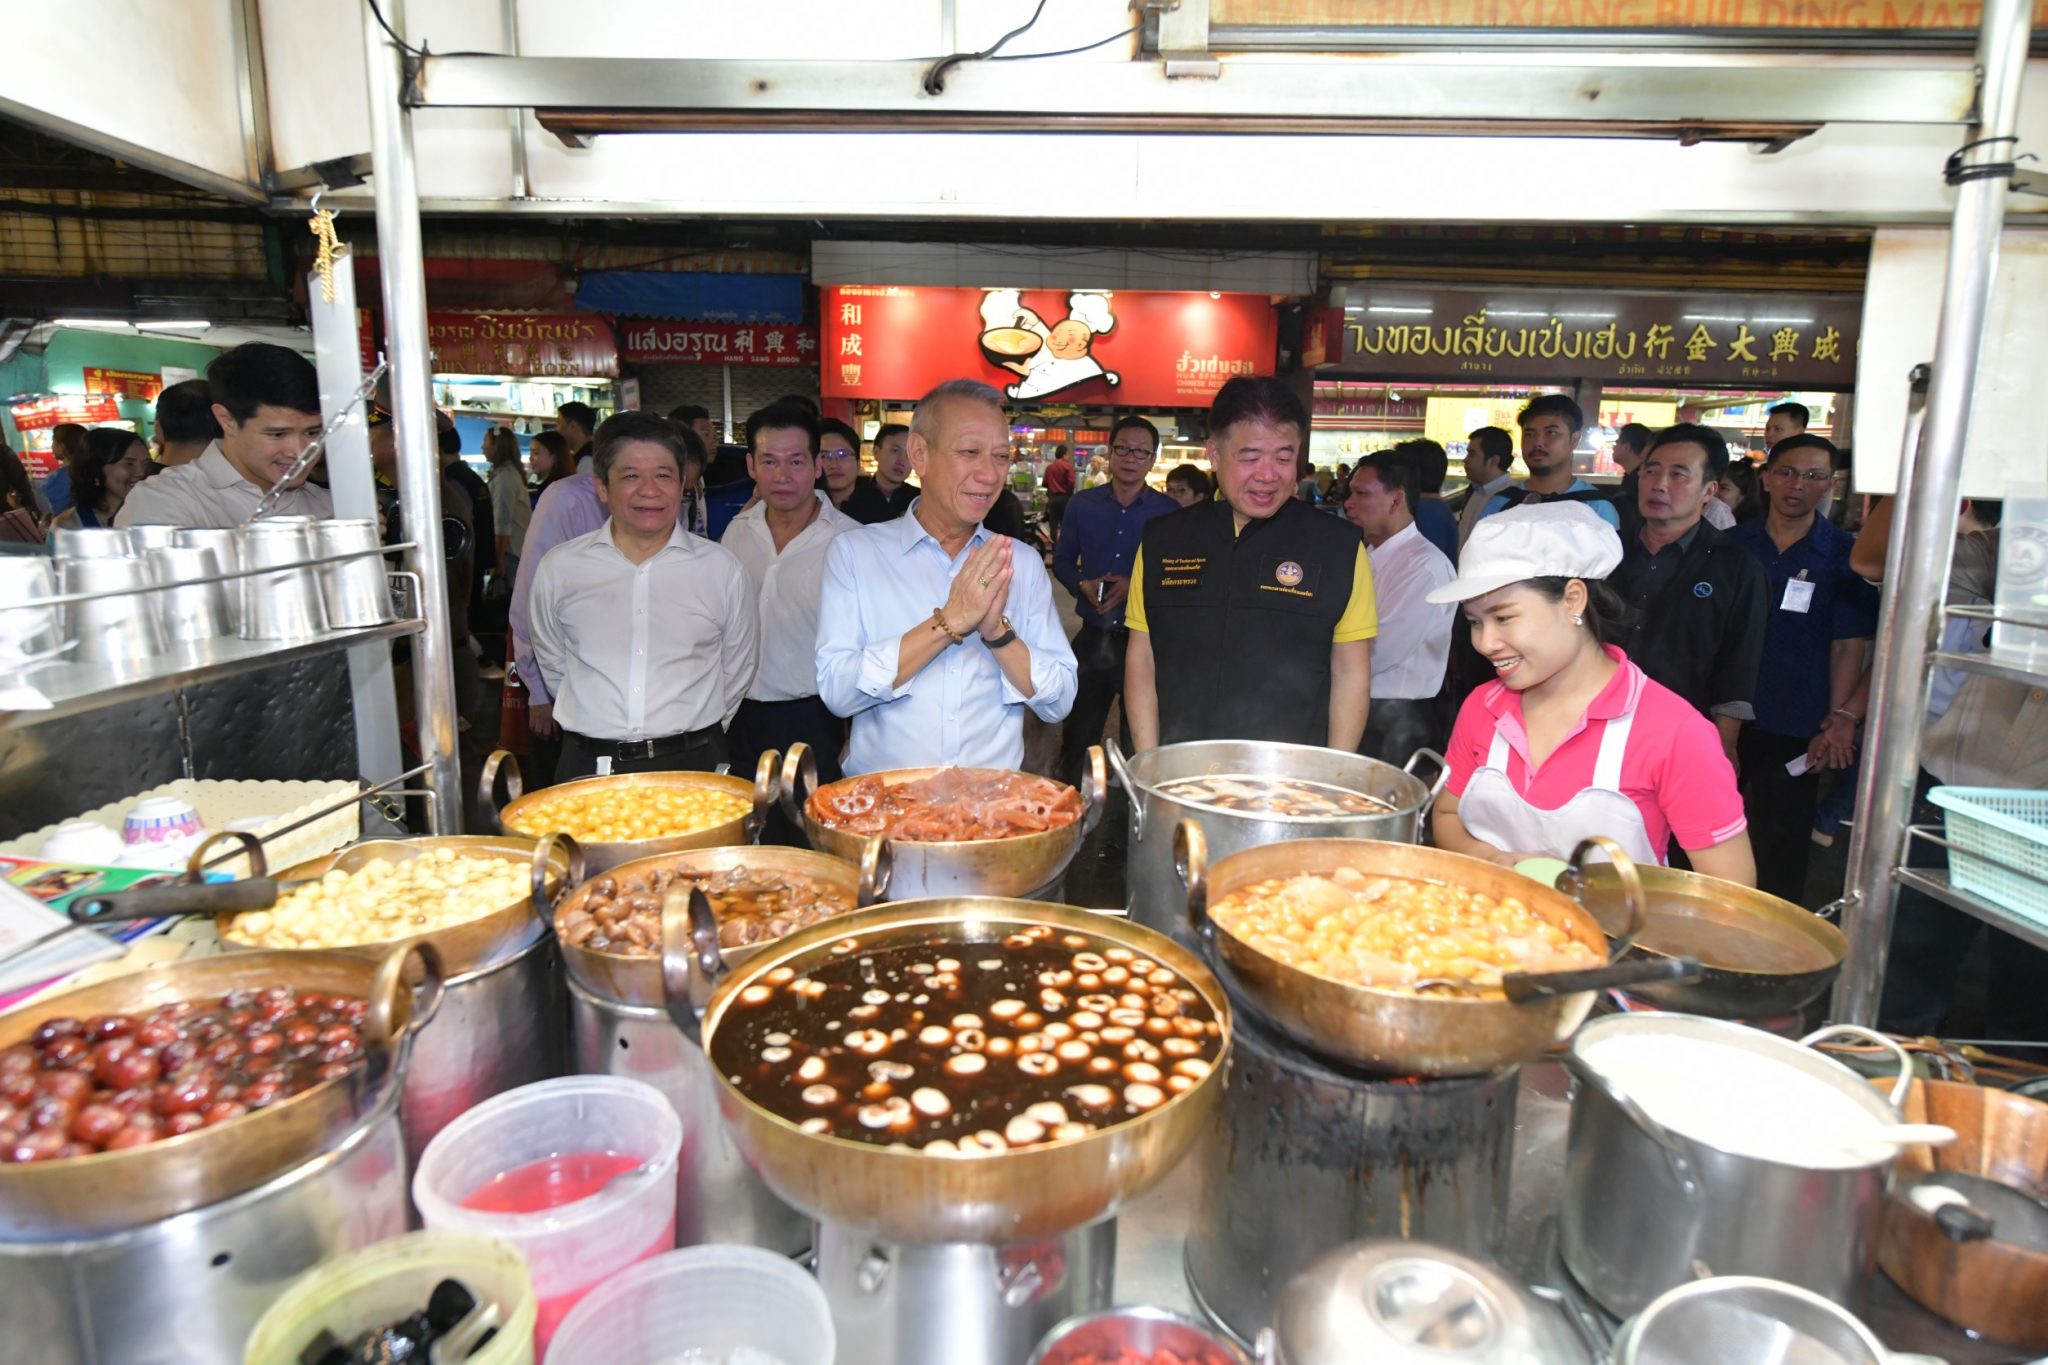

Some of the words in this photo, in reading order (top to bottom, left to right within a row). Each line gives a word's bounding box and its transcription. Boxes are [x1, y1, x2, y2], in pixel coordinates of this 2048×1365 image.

[1656, 0, 1867, 28] BUILDING
[628, 327, 728, 361] แสงอรุณ
[1176, 372, 1195, 380] HUA
[1198, 372, 1224, 381] SENG
[1208, 380, 1227, 388] REST
